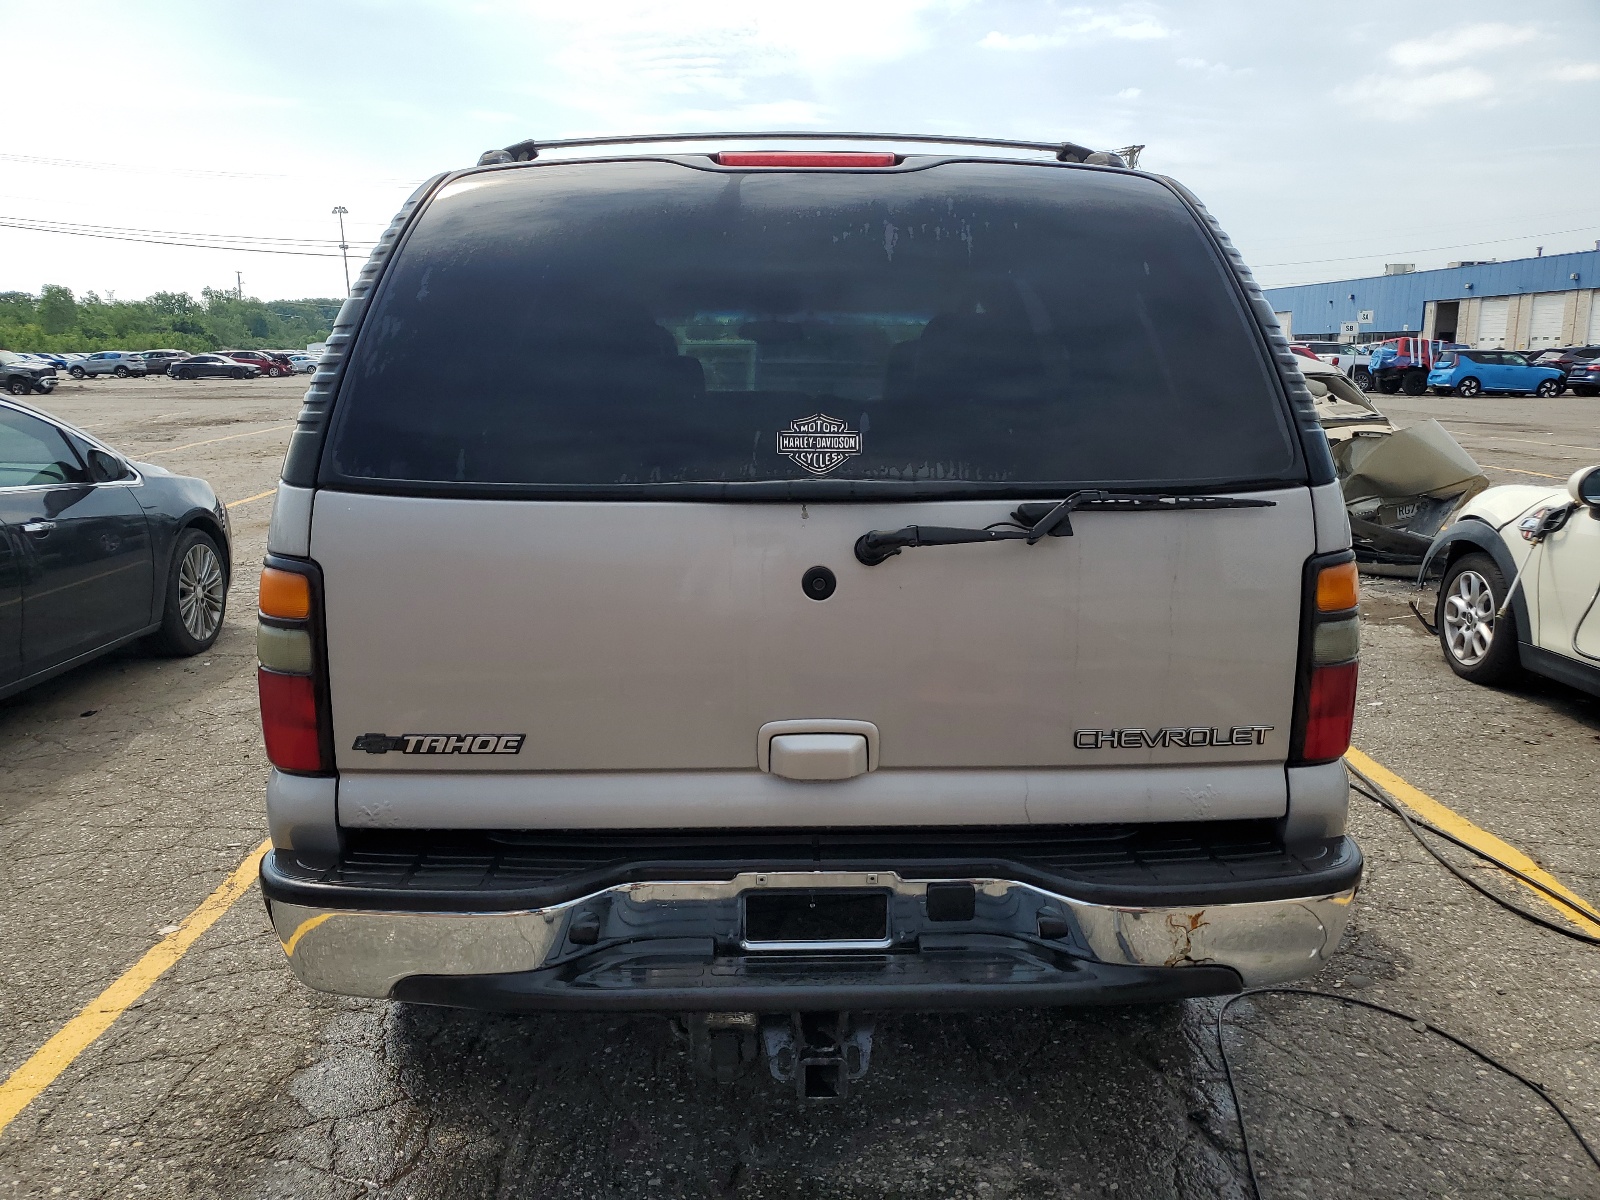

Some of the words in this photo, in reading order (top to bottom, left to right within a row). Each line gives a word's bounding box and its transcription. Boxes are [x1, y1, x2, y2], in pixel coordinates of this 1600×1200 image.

[800, 420, 838, 432] MOTOR
[783, 436, 855, 448] HARLEY-DAVIDSON
[800, 452, 838, 468] CYCLES
[402, 734, 525, 754] TAHOE
[1074, 724, 1275, 748] CHEVROLET
